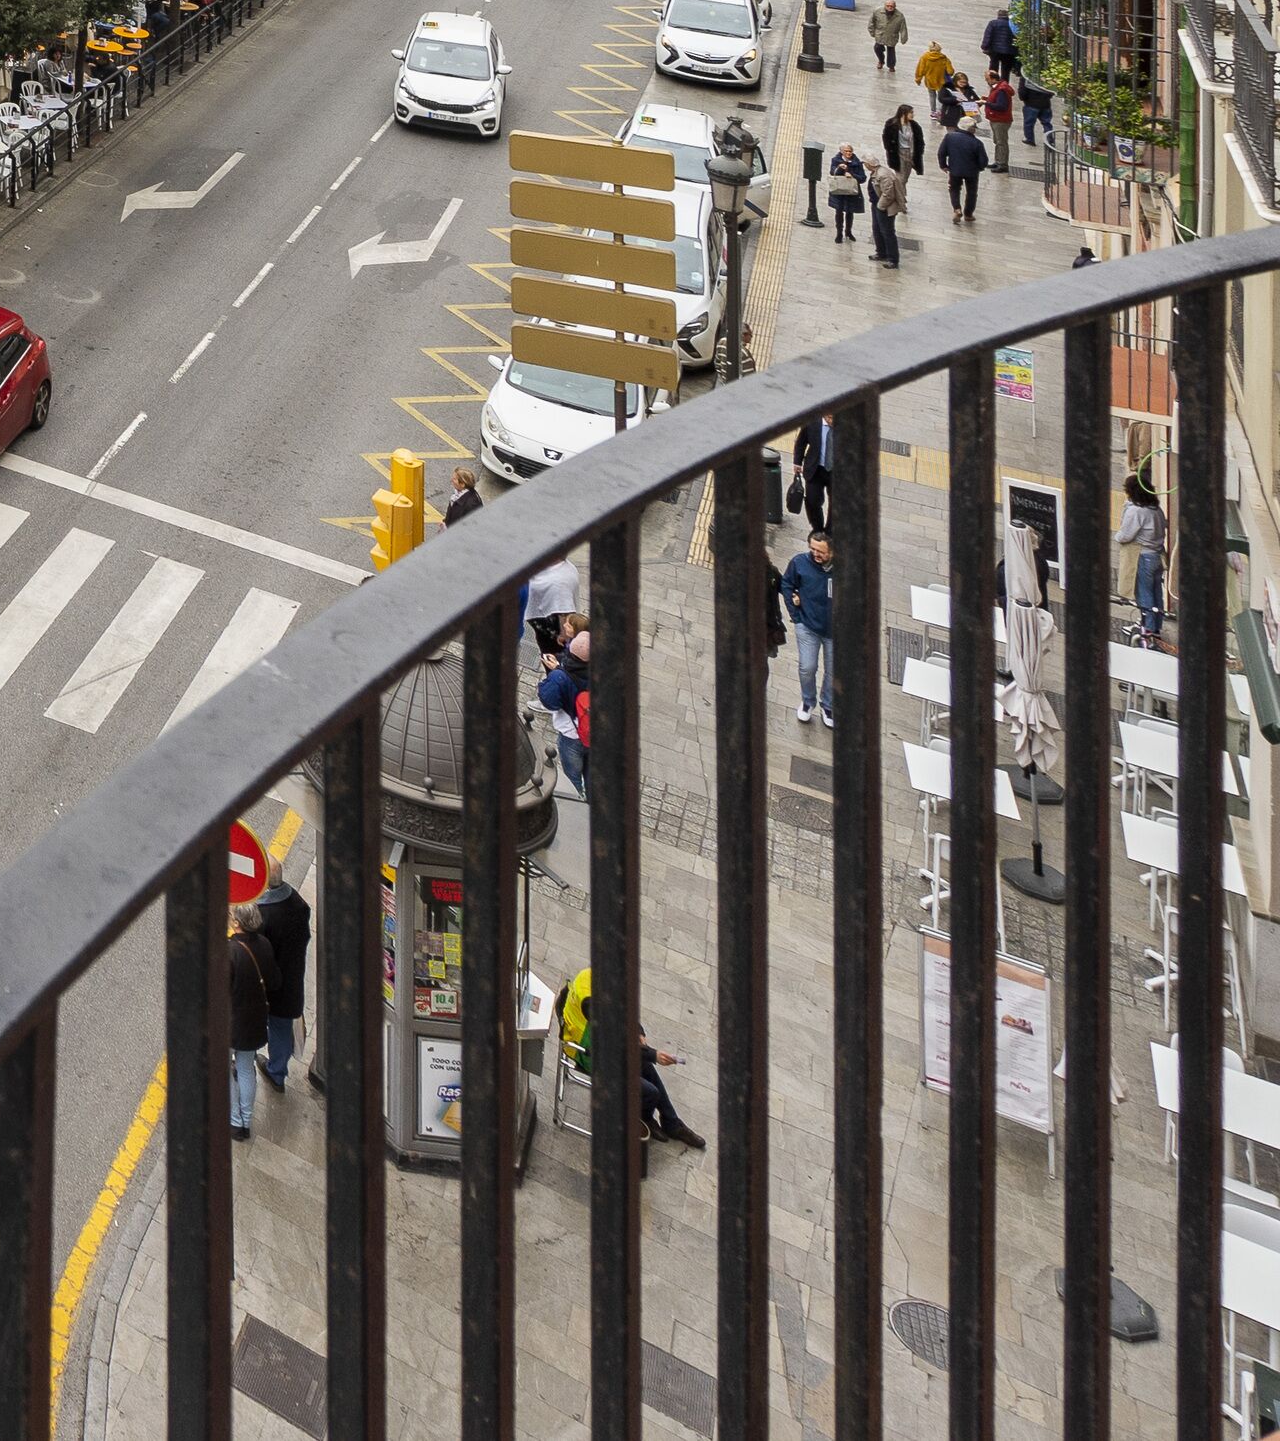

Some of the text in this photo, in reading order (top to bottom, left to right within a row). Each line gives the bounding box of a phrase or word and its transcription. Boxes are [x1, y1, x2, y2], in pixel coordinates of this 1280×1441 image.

[431, 1057, 450, 1065] TODO
[445, 1064, 462, 1072] UNA
[438, 1085, 462, 1098] Ras
